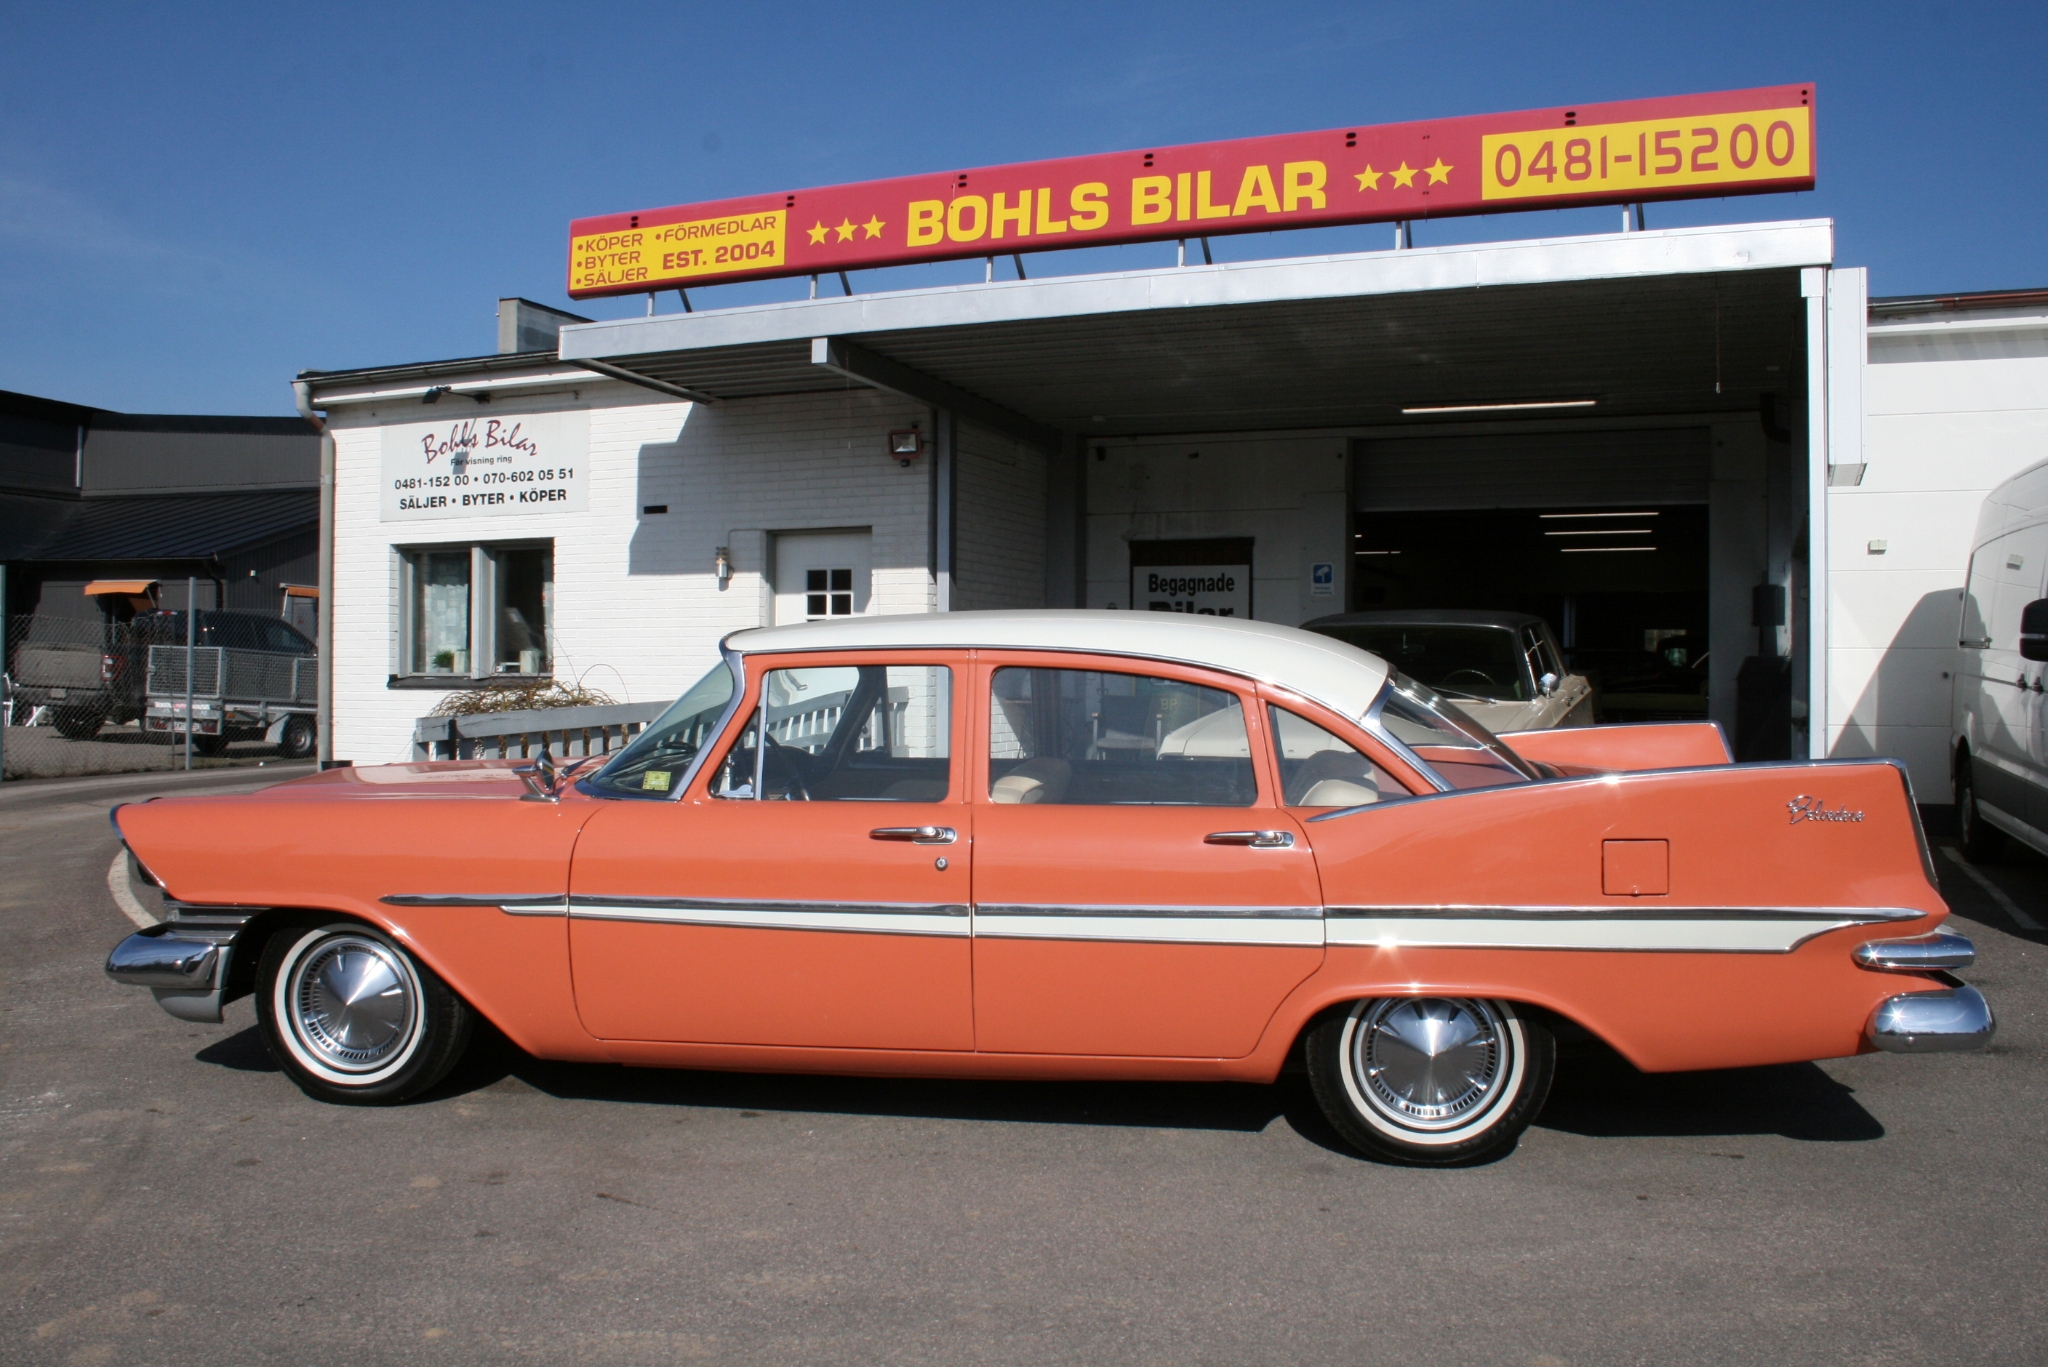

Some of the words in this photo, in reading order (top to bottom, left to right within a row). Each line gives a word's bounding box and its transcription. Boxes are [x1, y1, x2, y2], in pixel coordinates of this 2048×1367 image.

[1494, 120, 1795, 188] 0481-15200
[907, 182, 1109, 247] BOHLS
[1131, 160, 1327, 226] BILAR
[663, 216, 776, 242] FÖRMEDLAR
[585, 233, 643, 252] KÖPER
[584, 251, 641, 270] BYTER
[662, 249, 707, 270] EST.
[715, 240, 775, 264] 2004
[584, 267, 648, 287] SÄLJER
[421, 421, 479, 464] Bohls
[484, 420, 537, 456] Bilar
[466, 456, 494, 466] visning
[496, 455, 513, 464] ring
[394, 475, 450, 490] 0481-152
[454, 474, 470, 486] 00
[483, 470, 534, 484] 070-602
[538, 469, 554, 481] 05
[558, 468, 574, 480] 51
[399, 495, 448, 510] SÄLJER
[462, 492, 505, 506] BYTER
[519, 487, 567, 503] KÖPER
[1148, 573, 1235, 597] Begagnade
